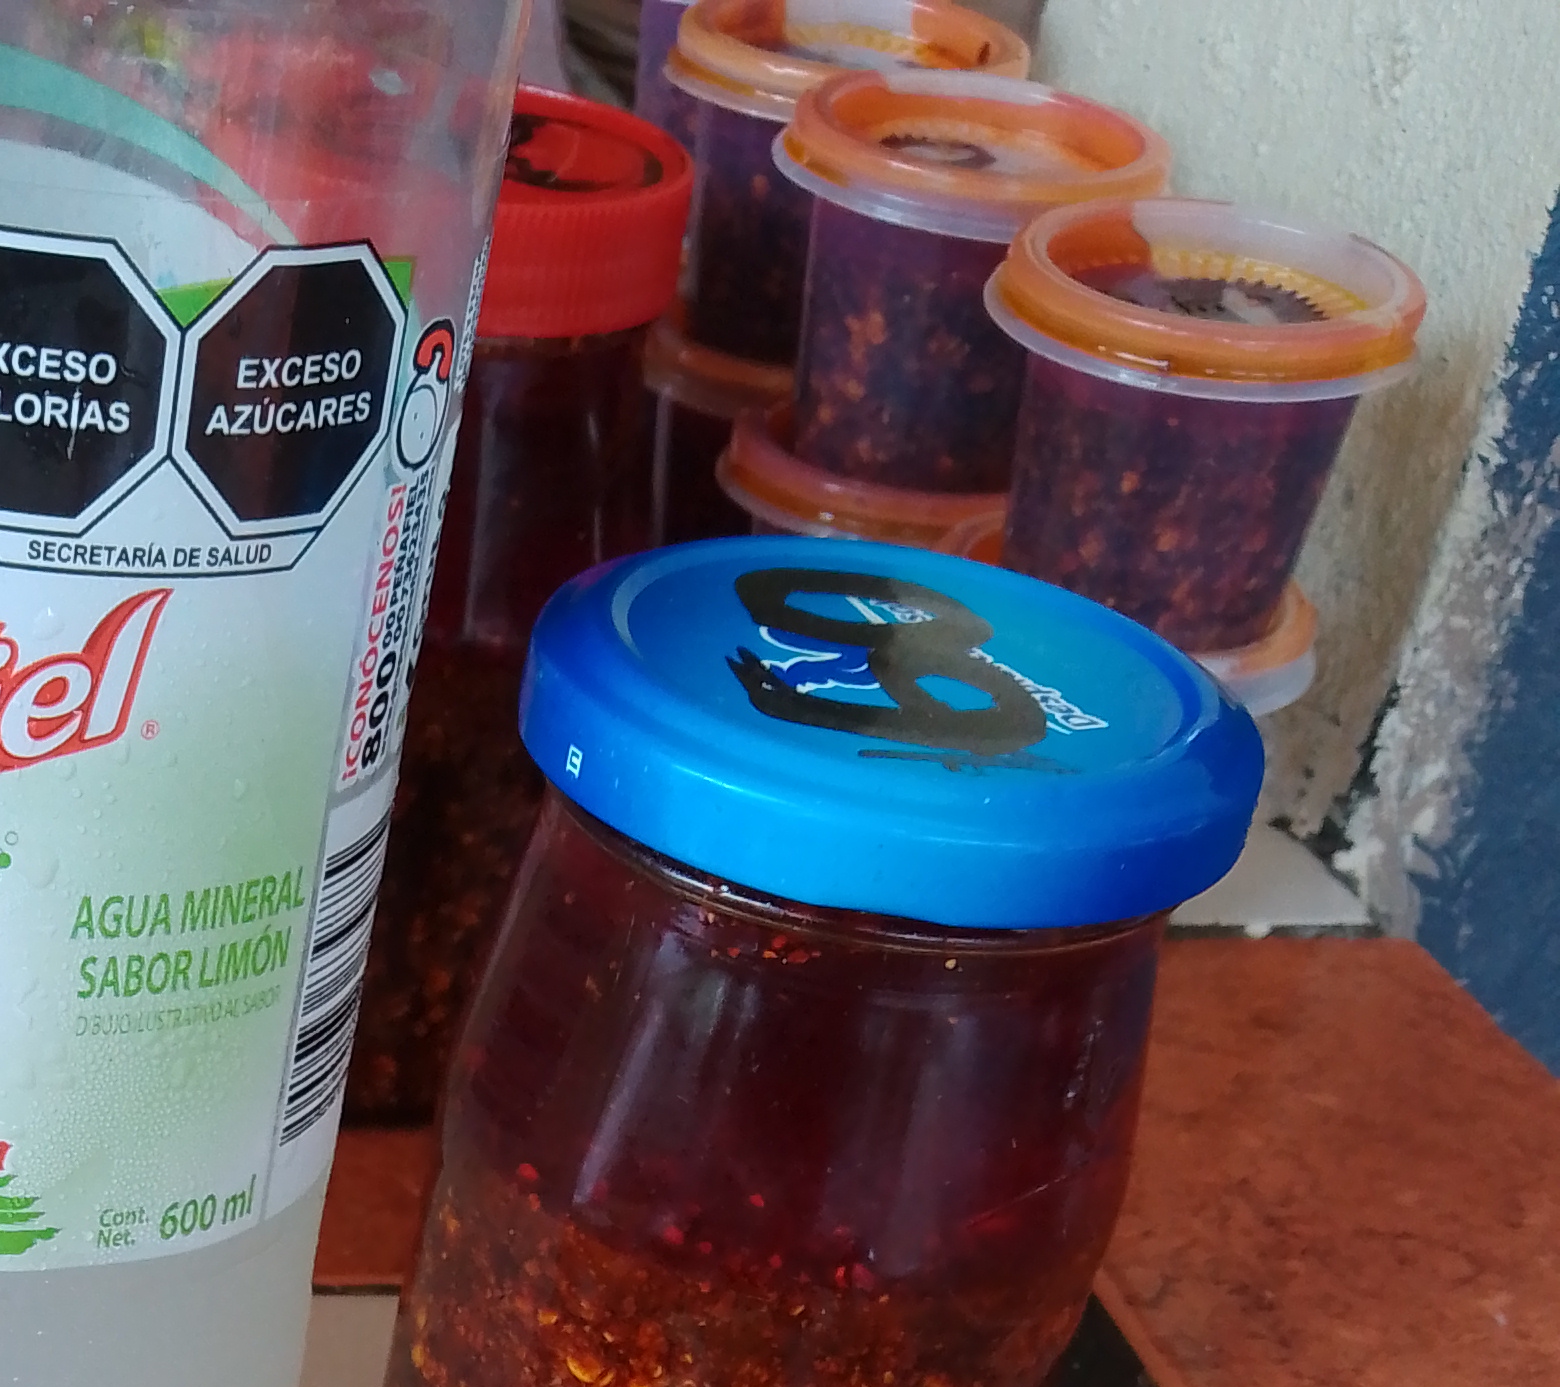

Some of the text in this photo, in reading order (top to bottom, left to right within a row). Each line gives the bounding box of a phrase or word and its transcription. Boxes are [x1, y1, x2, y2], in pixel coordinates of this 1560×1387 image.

[236, 350, 361, 389] EXCESO
[204, 391, 371, 436] AZÚCARES
[27, 540, 272, 568] SECRETARÍA DE SALUD
[361, 651, 397, 769] 800
[70, 866, 306, 939] AGUA MINERAL
[77, 924, 292, 999] SABOR LIMÓN
[99, 1173, 257, 1240] Cont. 600 ml
[97, 1229, 136, 1249] Net.
